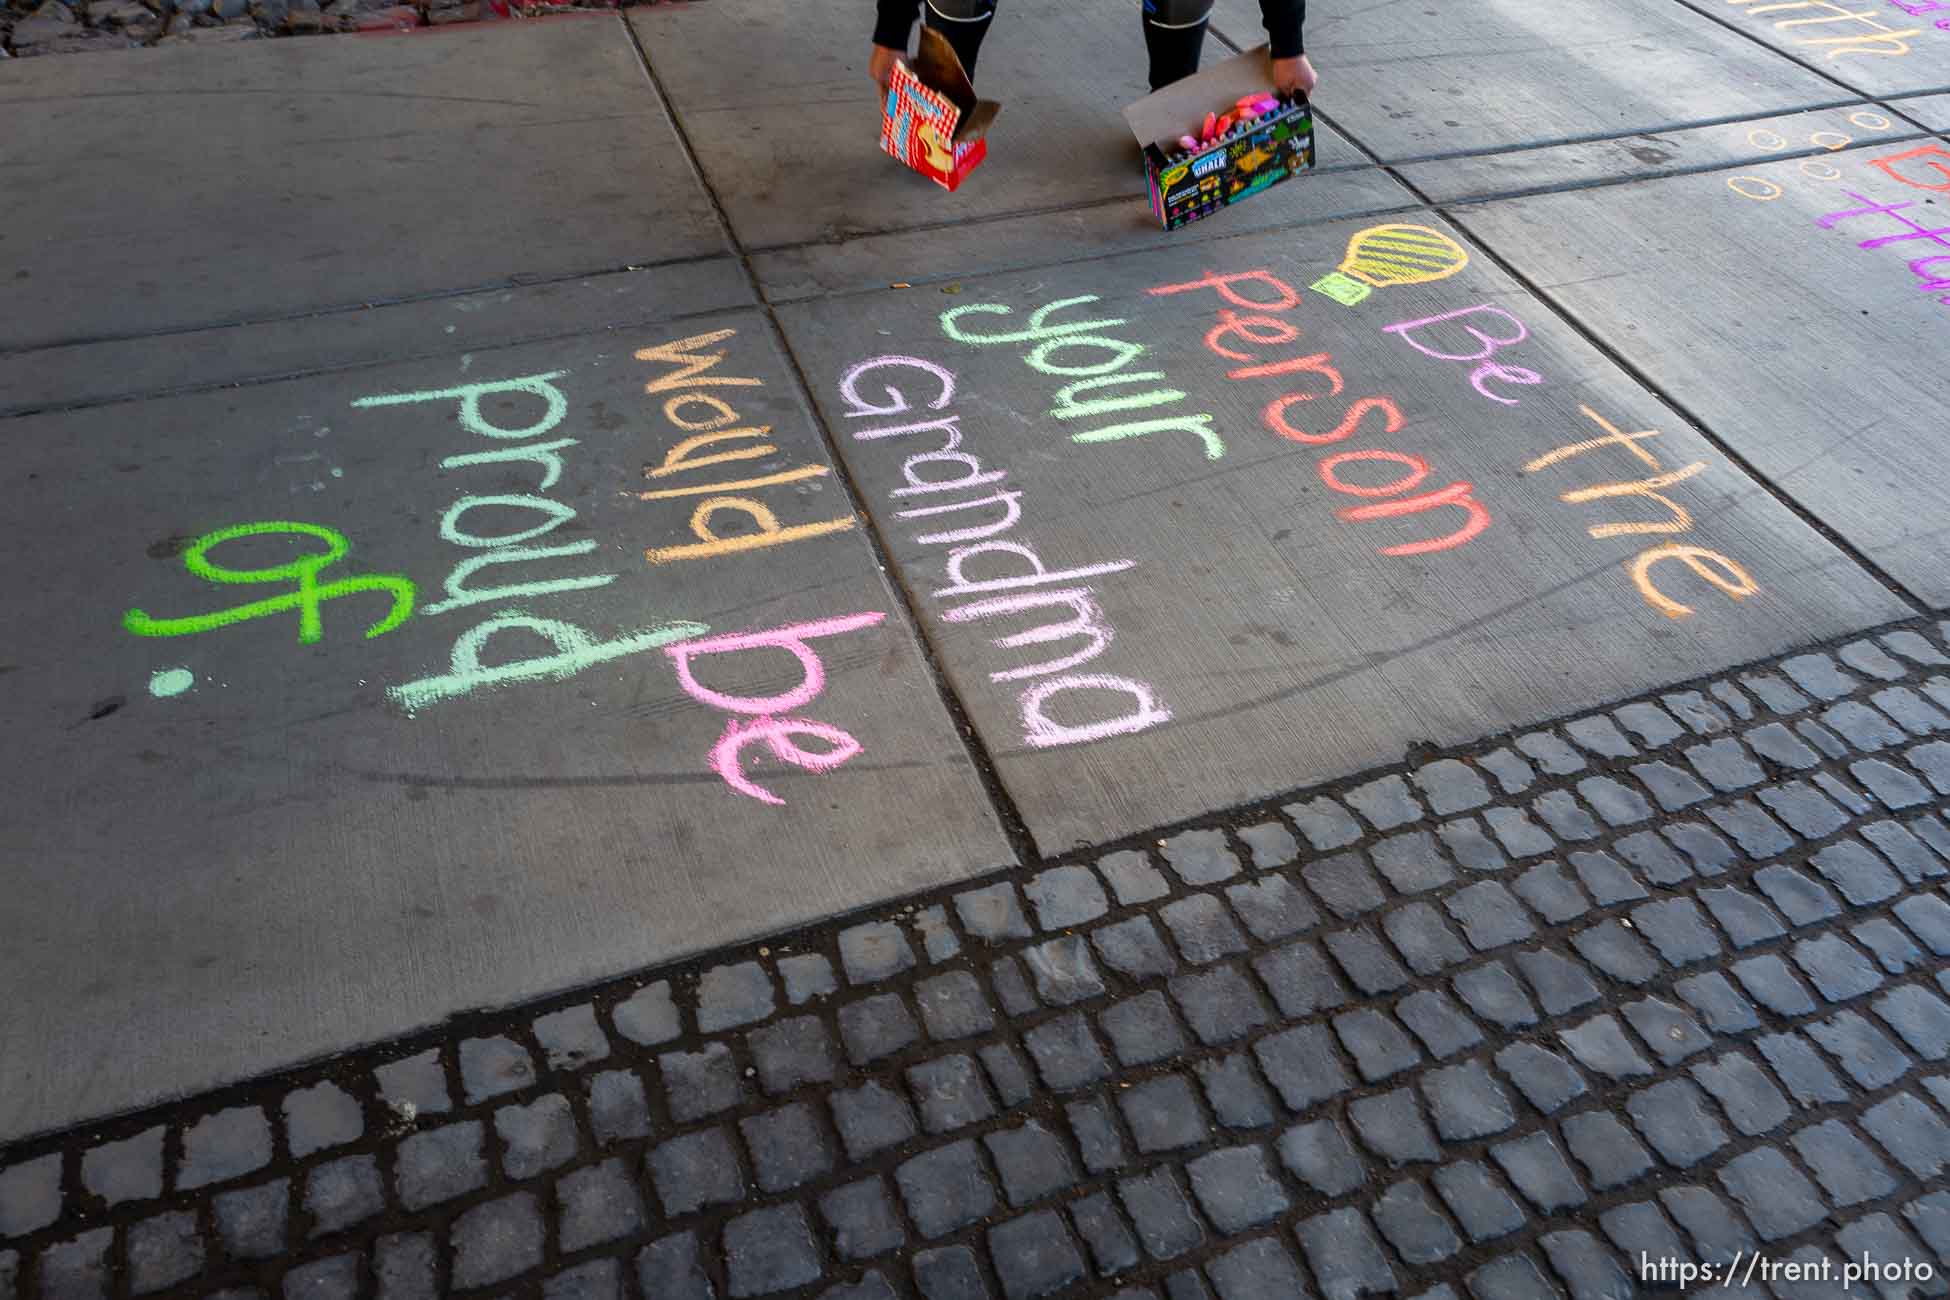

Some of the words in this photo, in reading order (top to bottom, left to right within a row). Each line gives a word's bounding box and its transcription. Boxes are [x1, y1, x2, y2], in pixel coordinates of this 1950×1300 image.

[940, 295, 1224, 460] your
[1382, 303, 1544, 406] Be
[1524, 404, 1760, 619] the
[350, 369, 711, 712] proud
[838, 354, 1173, 748] Grandma
[662, 611, 887, 804] be
